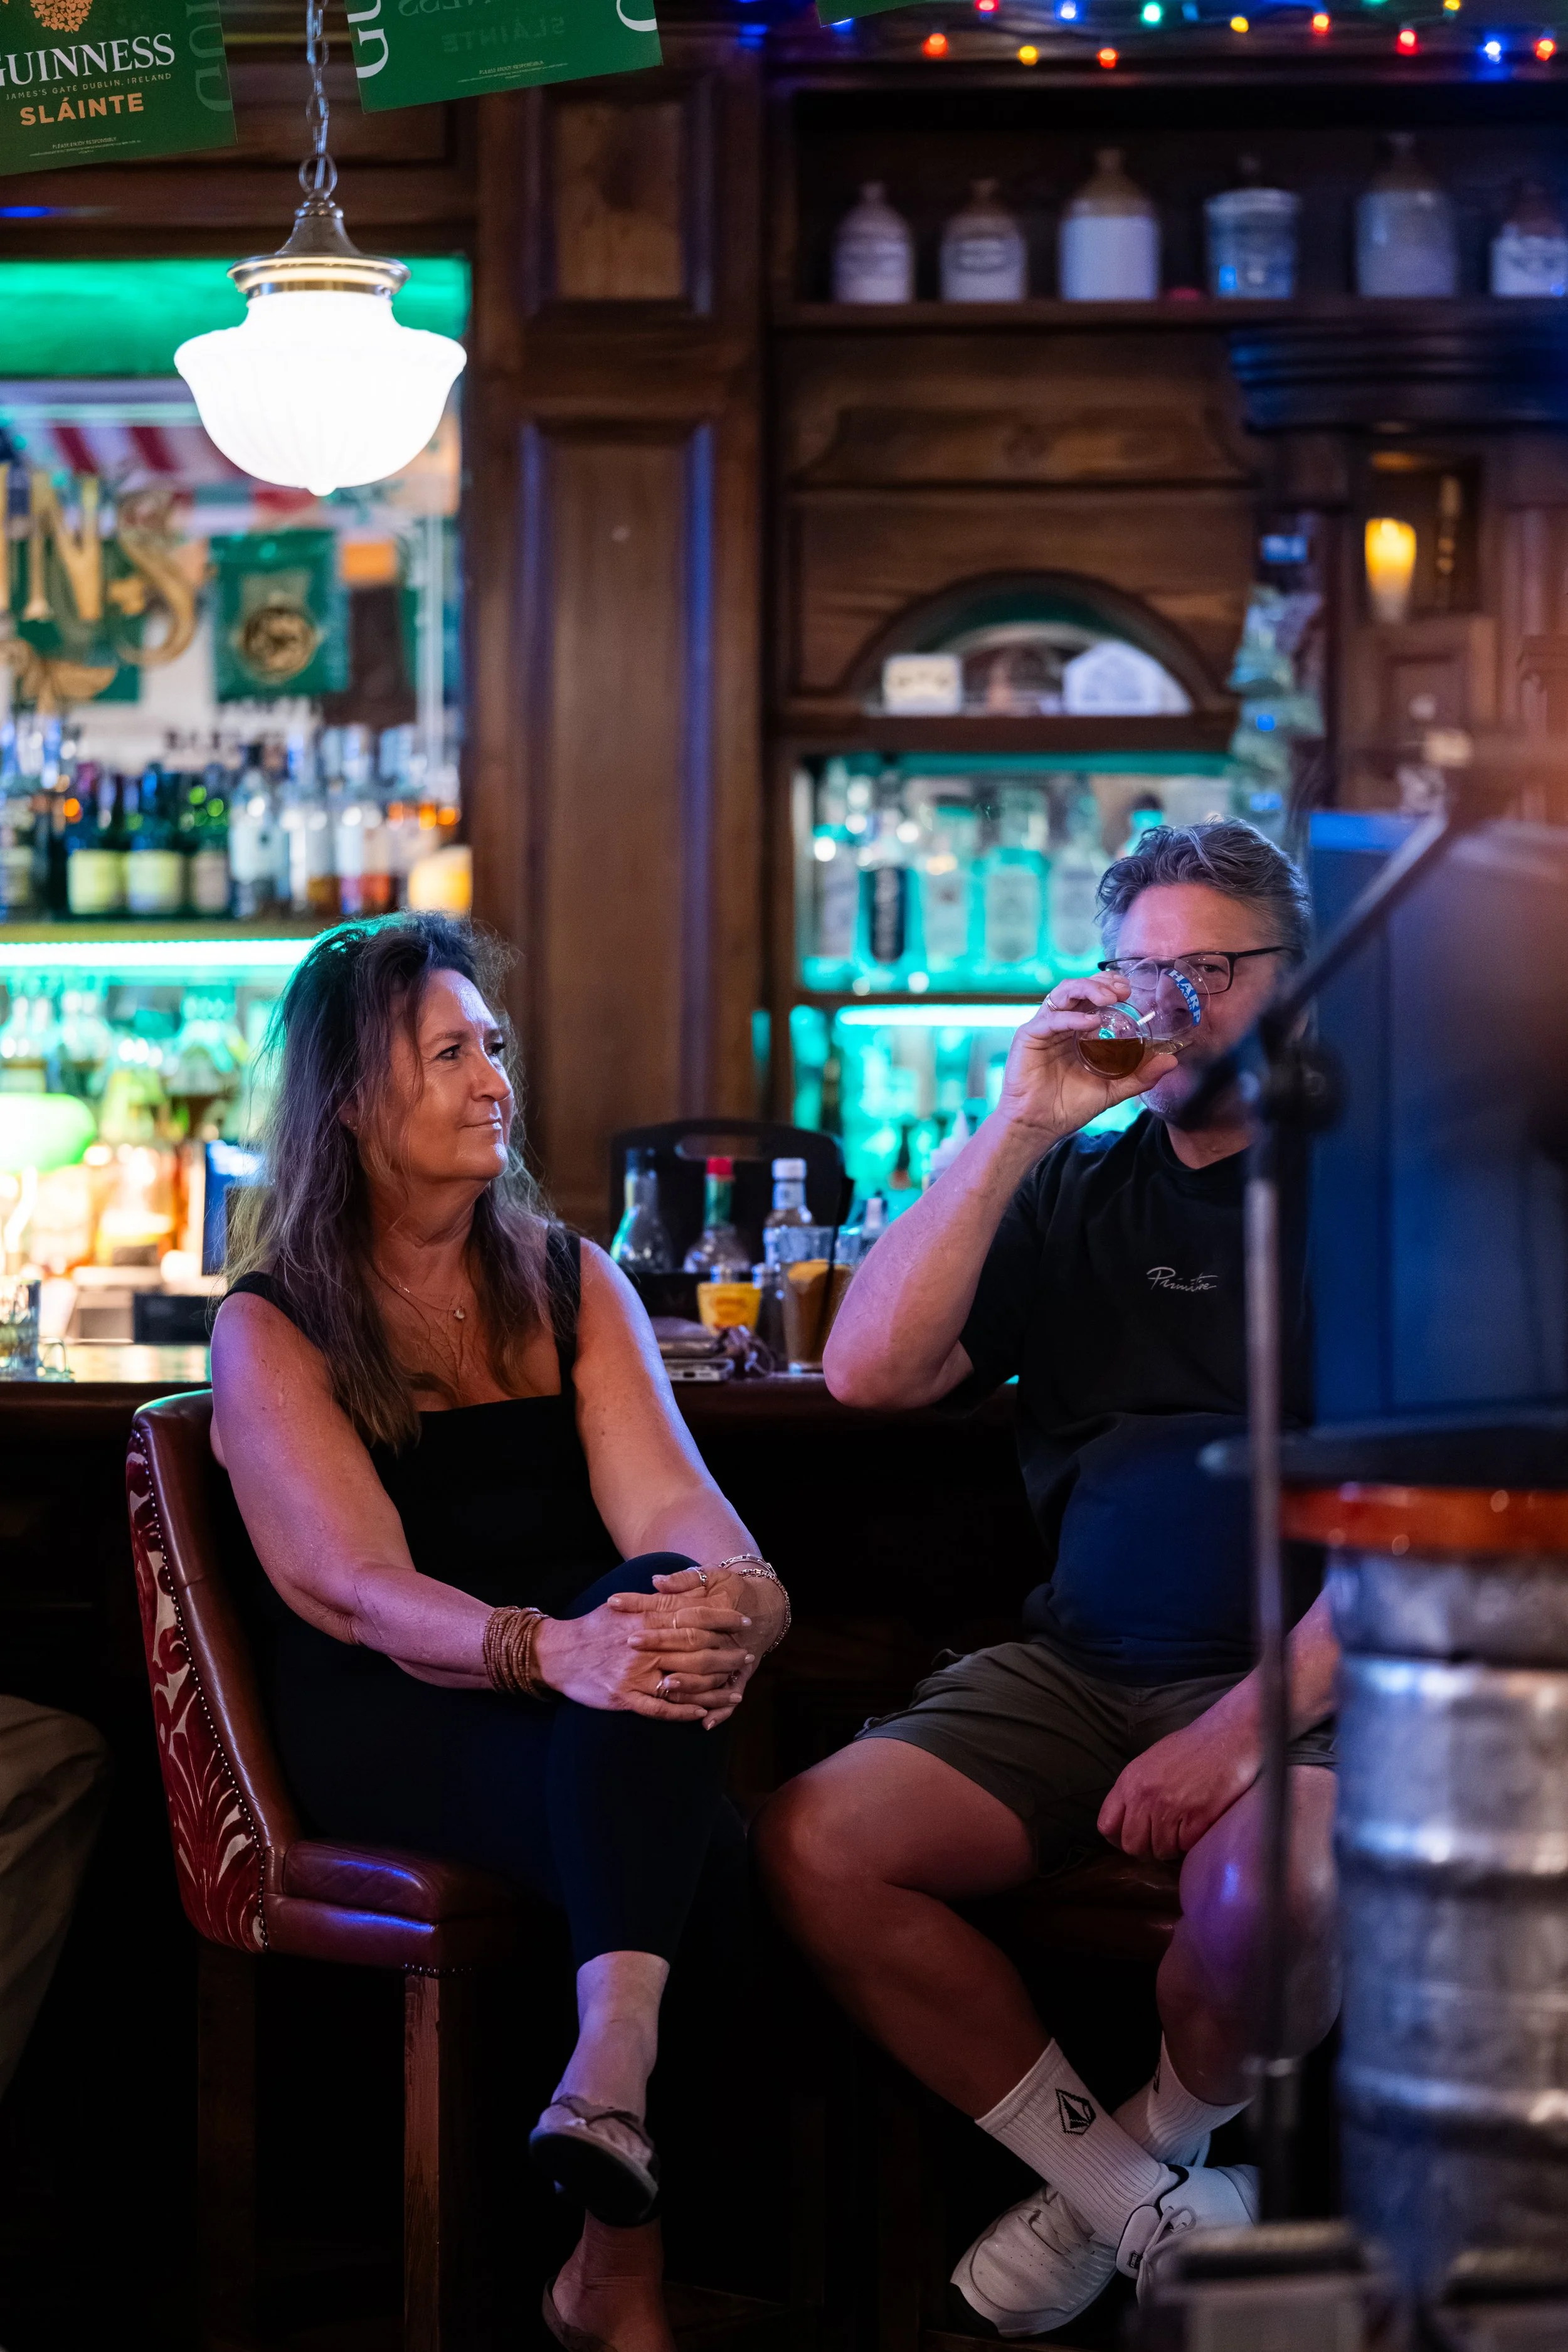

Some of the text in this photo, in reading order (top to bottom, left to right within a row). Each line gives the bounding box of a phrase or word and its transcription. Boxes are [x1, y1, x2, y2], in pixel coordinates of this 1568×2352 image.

[52, 85, 78, 95] GATE
[127, 73, 172, 85] IRELAND
[20, 93, 144, 126] SLÁINTE
[1168, 969, 1201, 1023] HARP
